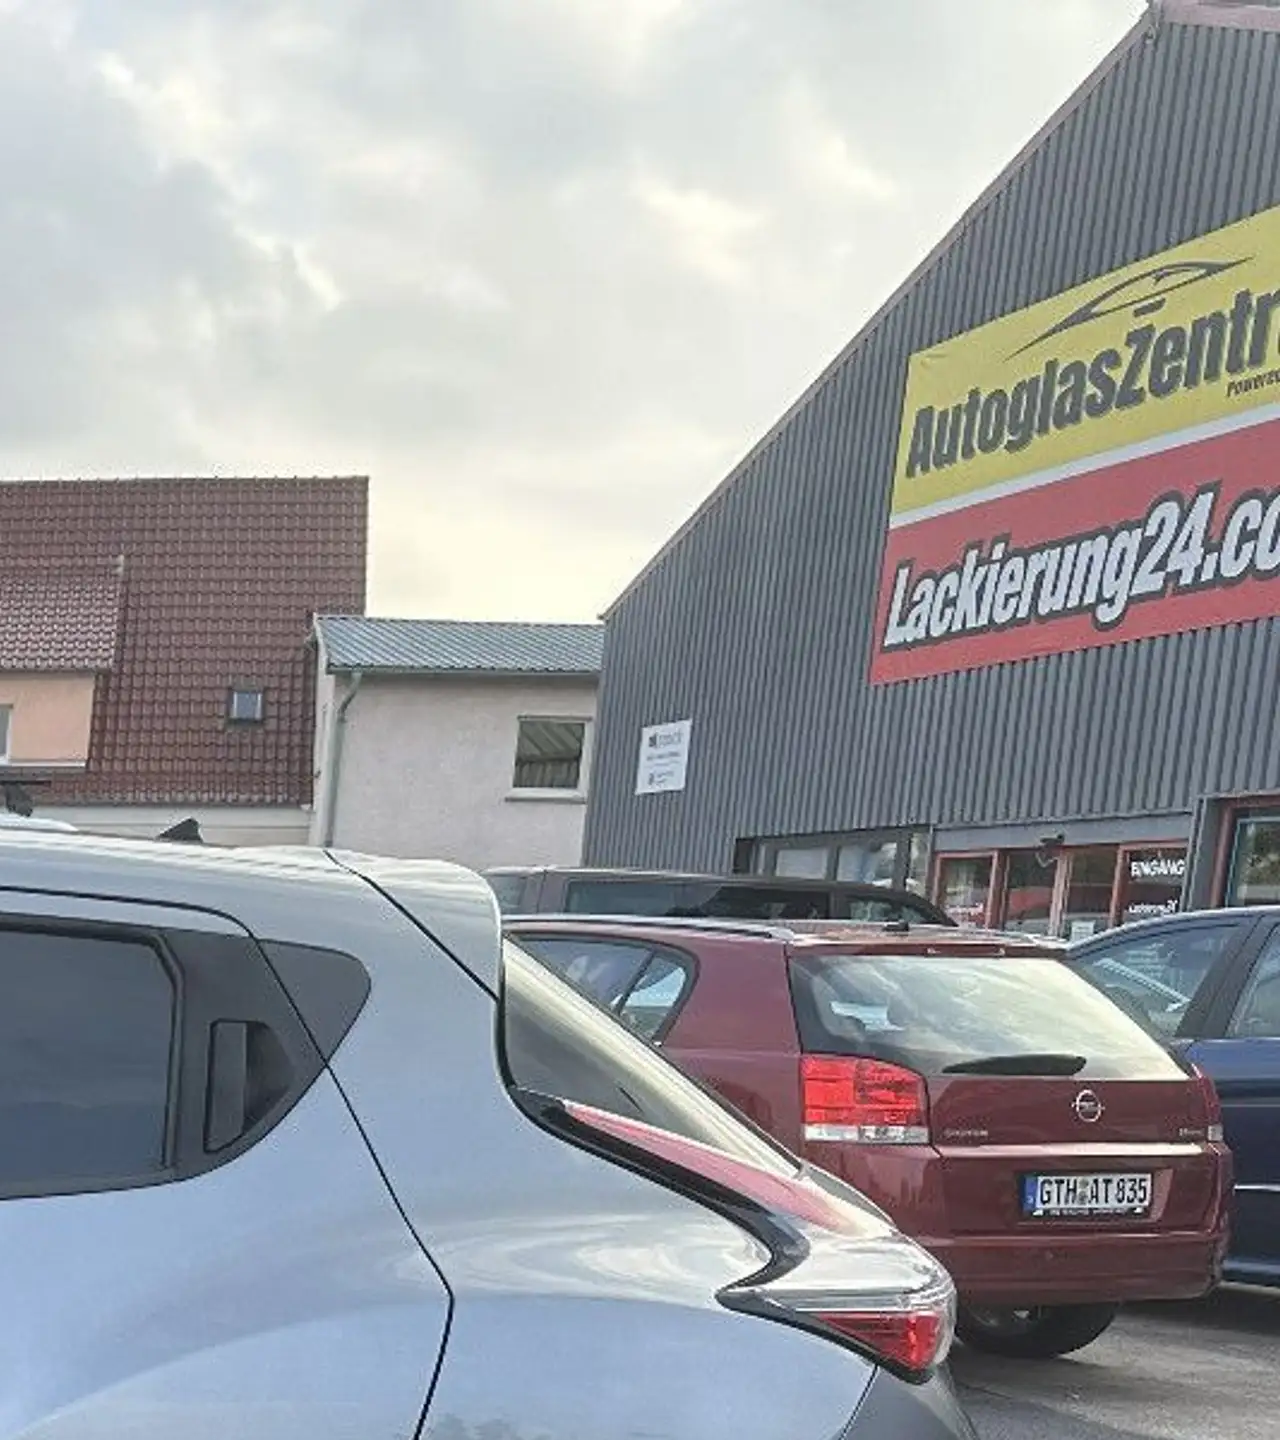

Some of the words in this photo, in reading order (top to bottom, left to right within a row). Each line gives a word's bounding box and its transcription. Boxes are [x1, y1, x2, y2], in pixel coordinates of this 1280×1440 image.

[906, 288, 1280, 478] AutoglasZentr
[1040, 1178, 1077, 1205] GTH
[1090, 1178, 1112, 1202] AT
[1116, 1176, 1148, 1203] 835
